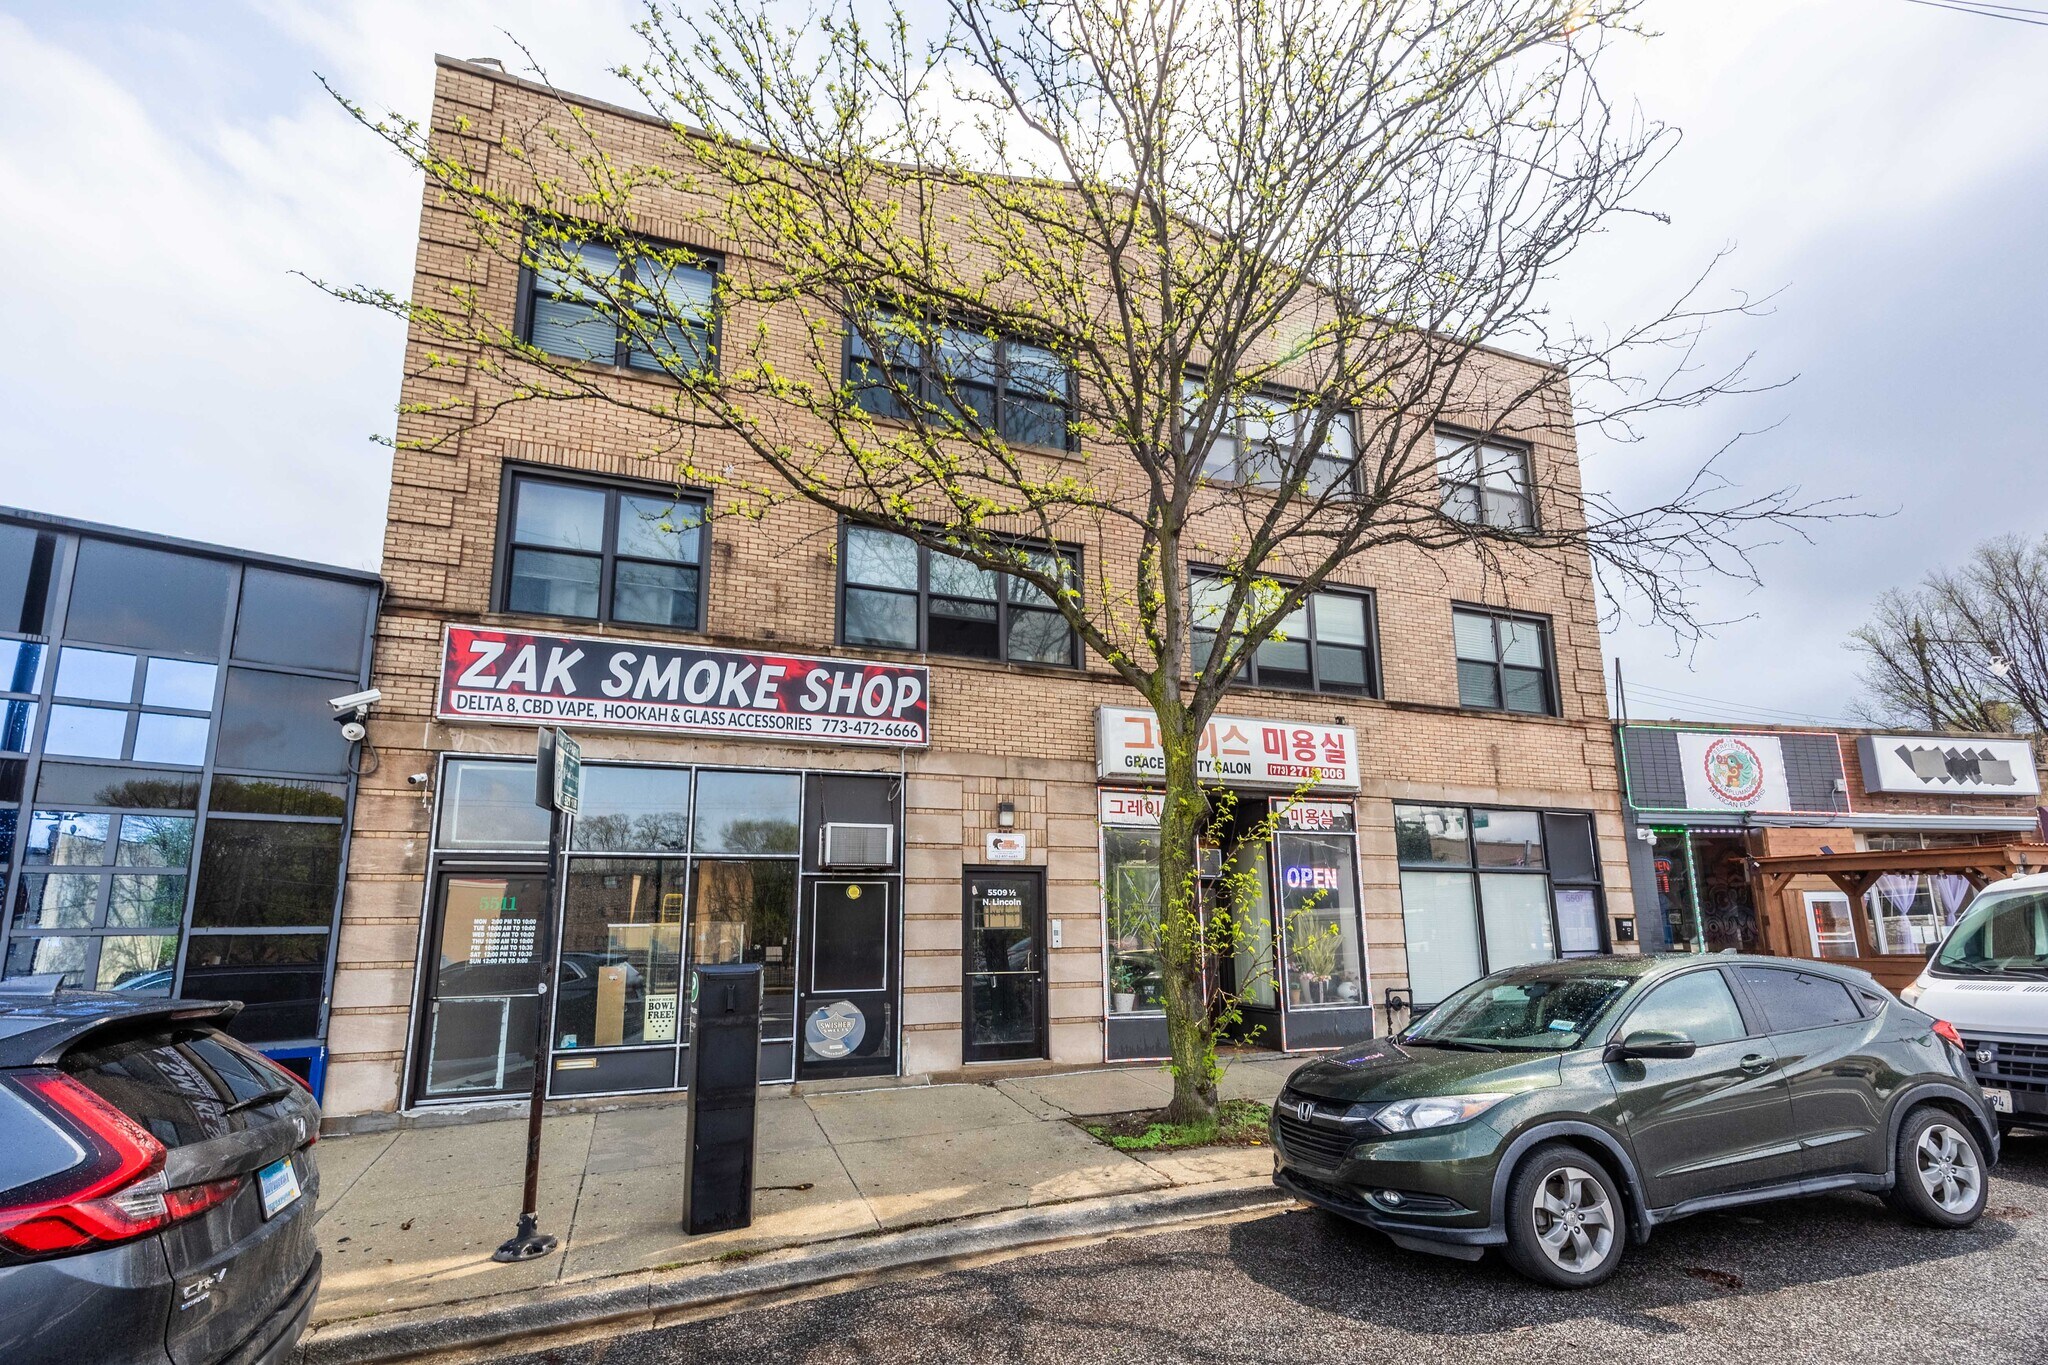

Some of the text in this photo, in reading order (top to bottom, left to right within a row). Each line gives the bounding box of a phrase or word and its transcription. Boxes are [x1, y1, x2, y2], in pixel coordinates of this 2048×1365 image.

[457, 641, 921, 718] ZAK SMOKE SHOP
[456, 694, 918, 738] DELTA 8, CBD VAPE, HOOKAH & GLASS ACCESSORIES 773-472-6666
[1125, 717, 1346, 764] 그이스 미용실
[1125, 755, 1164, 769] GRACE
[1215, 761, 1251, 774] SALON
[1269, 765, 1343, 779] (773) 271006
[1708, 786, 1766, 808] MEXICAN FLAVORS
[1109, 800, 1160, 817] 그레이
[1291, 808, 1334, 825] 미용실
[1286, 867, 1337, 889] OPEN
[480, 896, 517, 911] 5511
[992, 898, 1021, 906] Lincoln
[1566, 894, 1584, 902] 5507
[647, 1011, 674, 1019] FREE!
[648, 1002, 675, 1011] BOWL
[183, 1268, 227, 1299] CR-V
